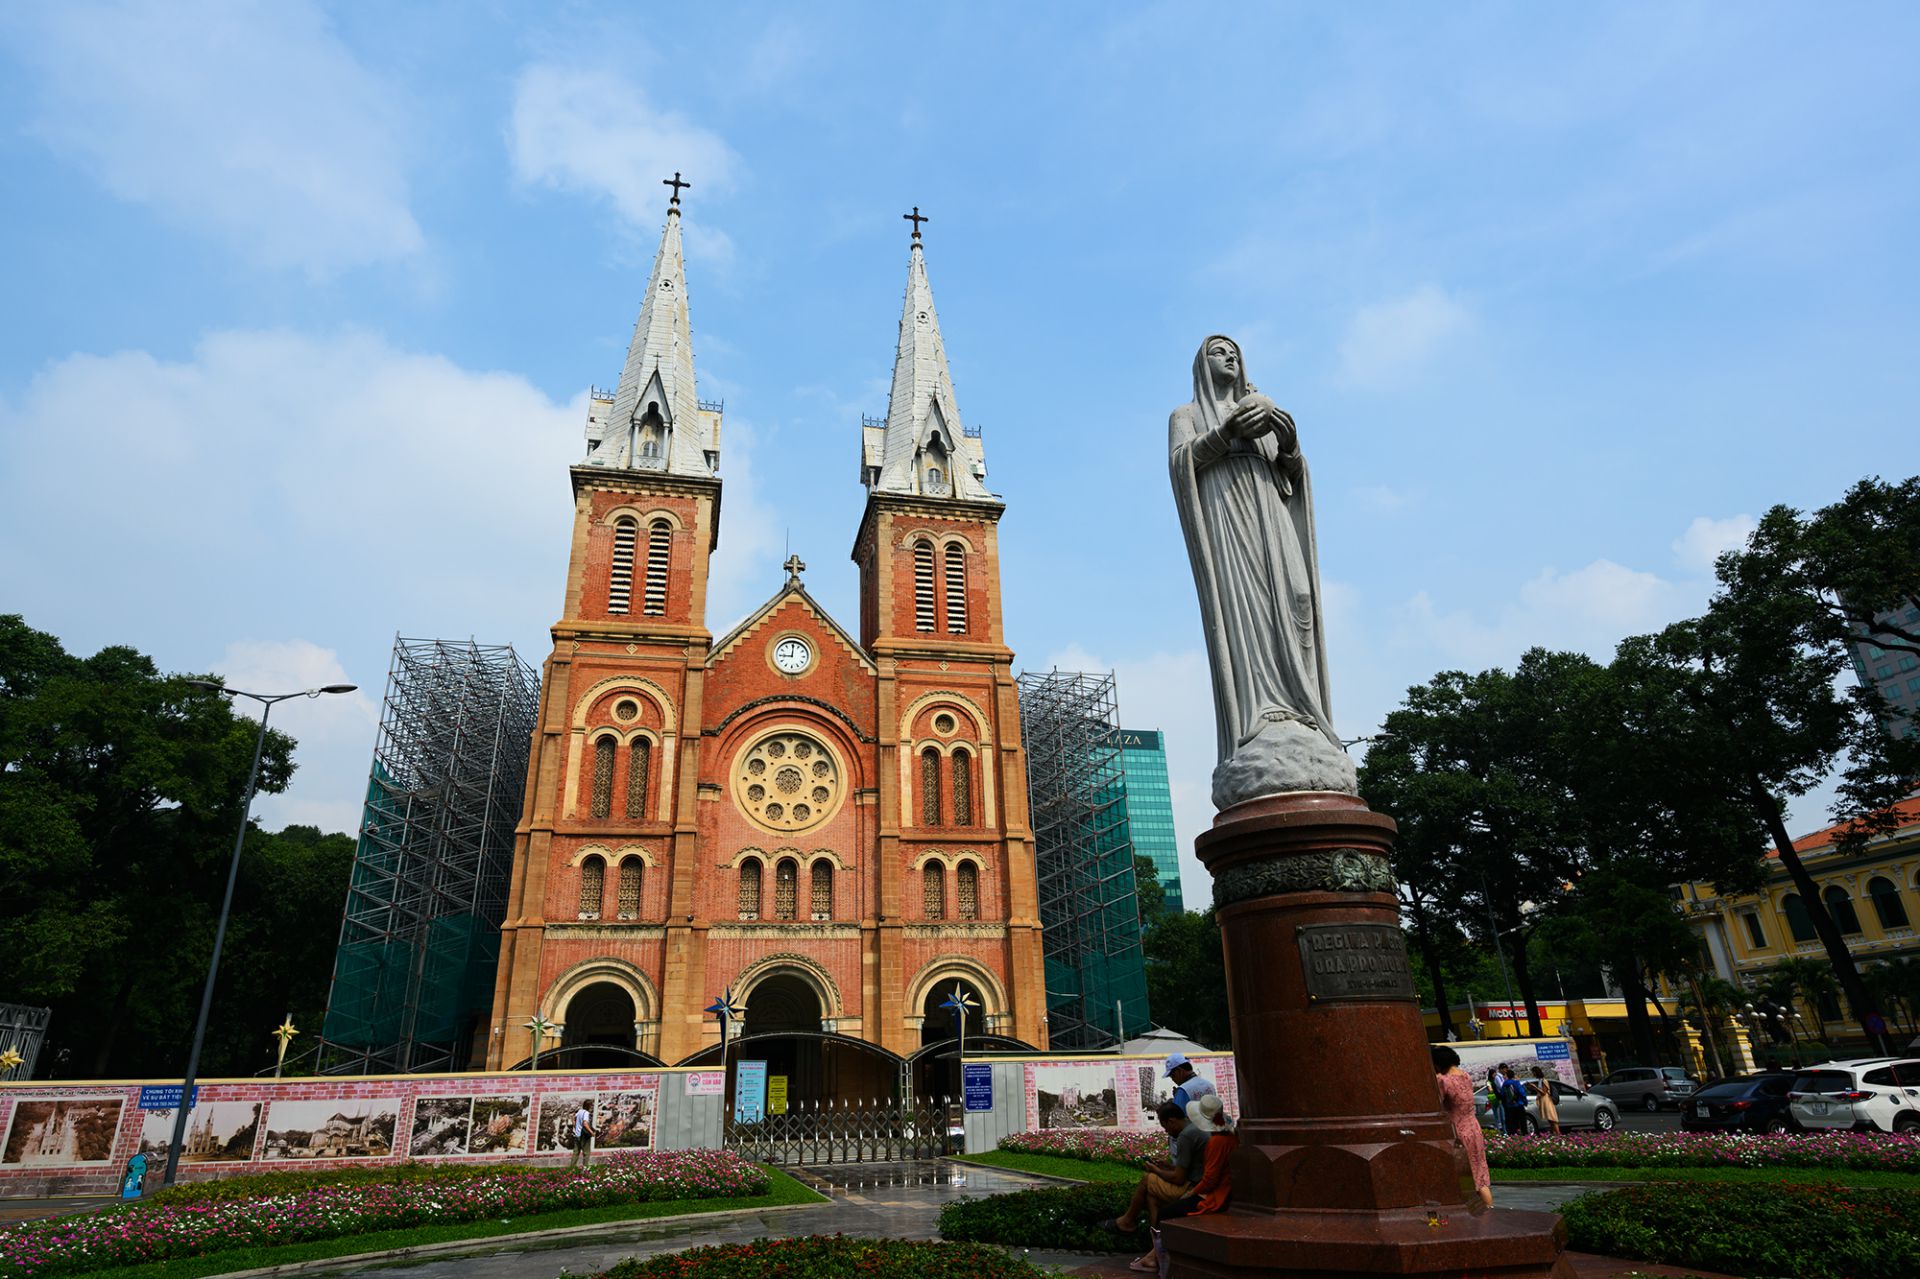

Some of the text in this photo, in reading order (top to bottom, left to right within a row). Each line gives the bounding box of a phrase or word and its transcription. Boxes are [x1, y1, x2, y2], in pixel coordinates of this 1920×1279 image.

[1106, 734, 1141, 744] LAZA
[1312, 932, 1369, 951] REGINA
[1314, 956, 1347, 974] ORA
[1348, 955, 1377, 973] PRO
